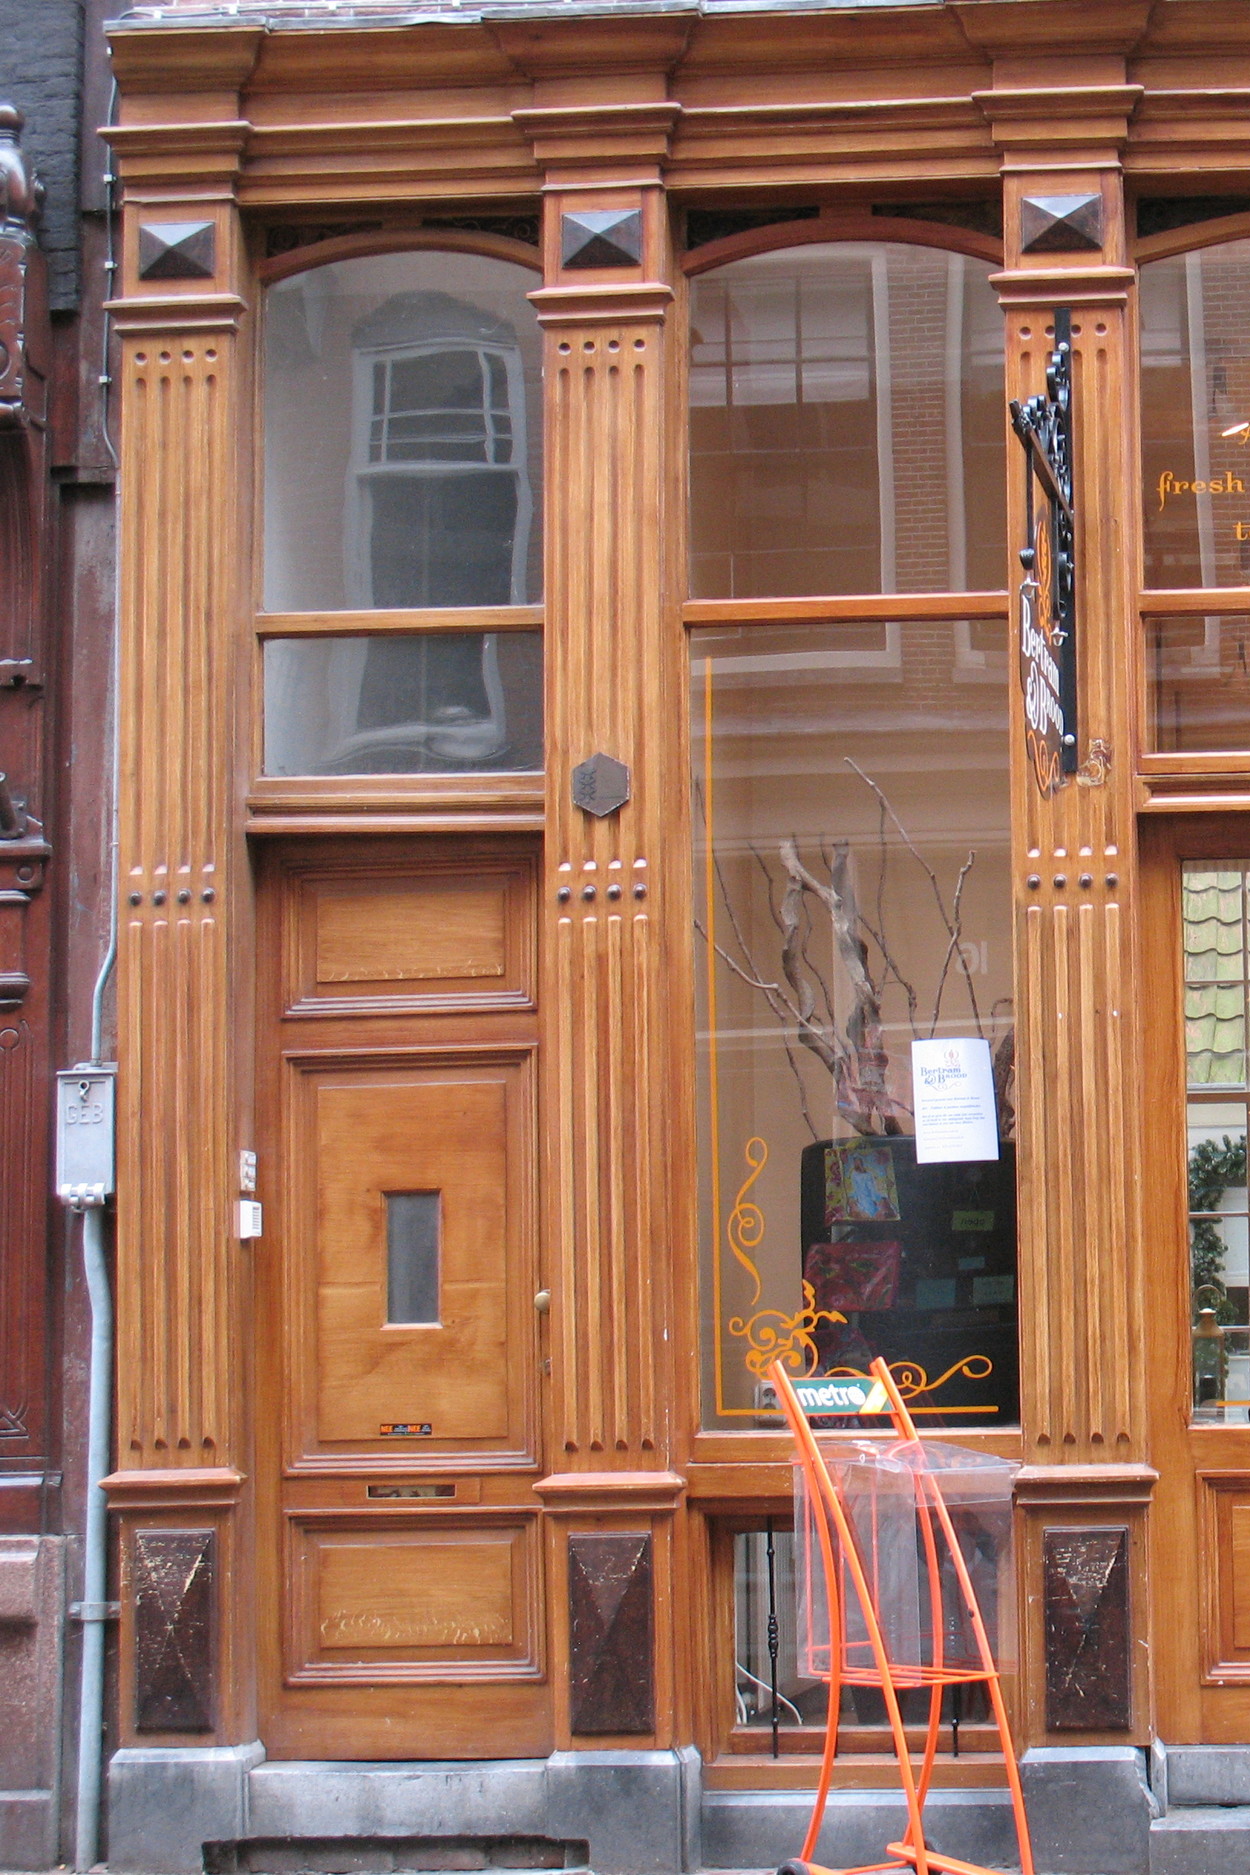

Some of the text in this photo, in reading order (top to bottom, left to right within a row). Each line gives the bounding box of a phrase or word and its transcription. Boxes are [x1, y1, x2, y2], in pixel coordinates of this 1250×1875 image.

[1156, 470, 1245, 511] fresh
[1021, 594, 1060, 698] Bertram
[920, 1066, 962, 1077] Bertram
[66, 1103, 104, 1126] GEB
[796, 1383, 867, 1407] metro
